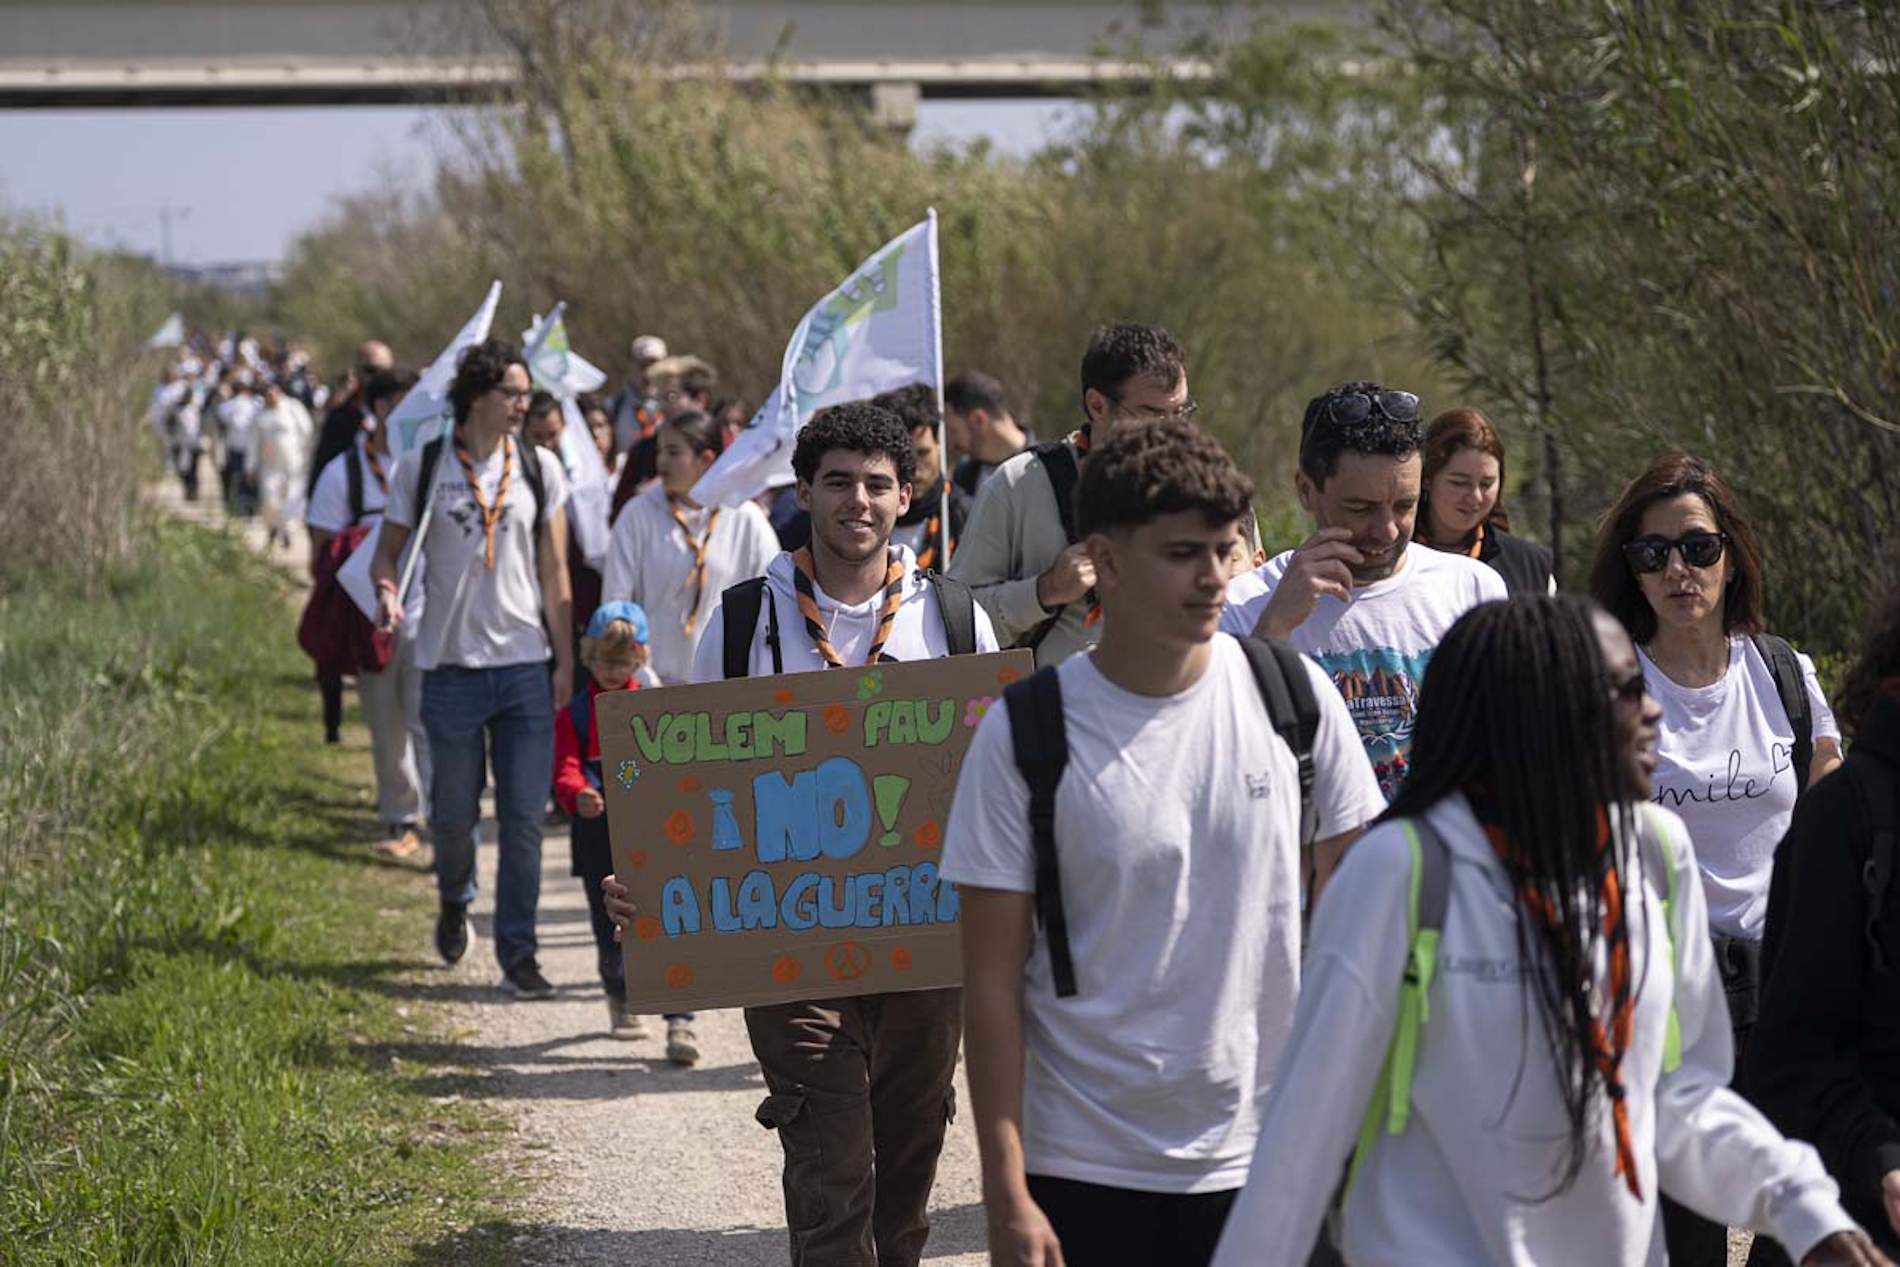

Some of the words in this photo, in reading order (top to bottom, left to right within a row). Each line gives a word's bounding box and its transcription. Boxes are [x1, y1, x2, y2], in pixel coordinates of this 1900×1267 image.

[631, 709, 808, 763] VOLEM
[863, 699, 956, 747] PAU
[1346, 696, 1406, 709] aTravessa
[1652, 749, 1769, 806] mile
[661, 875, 700, 936] A
